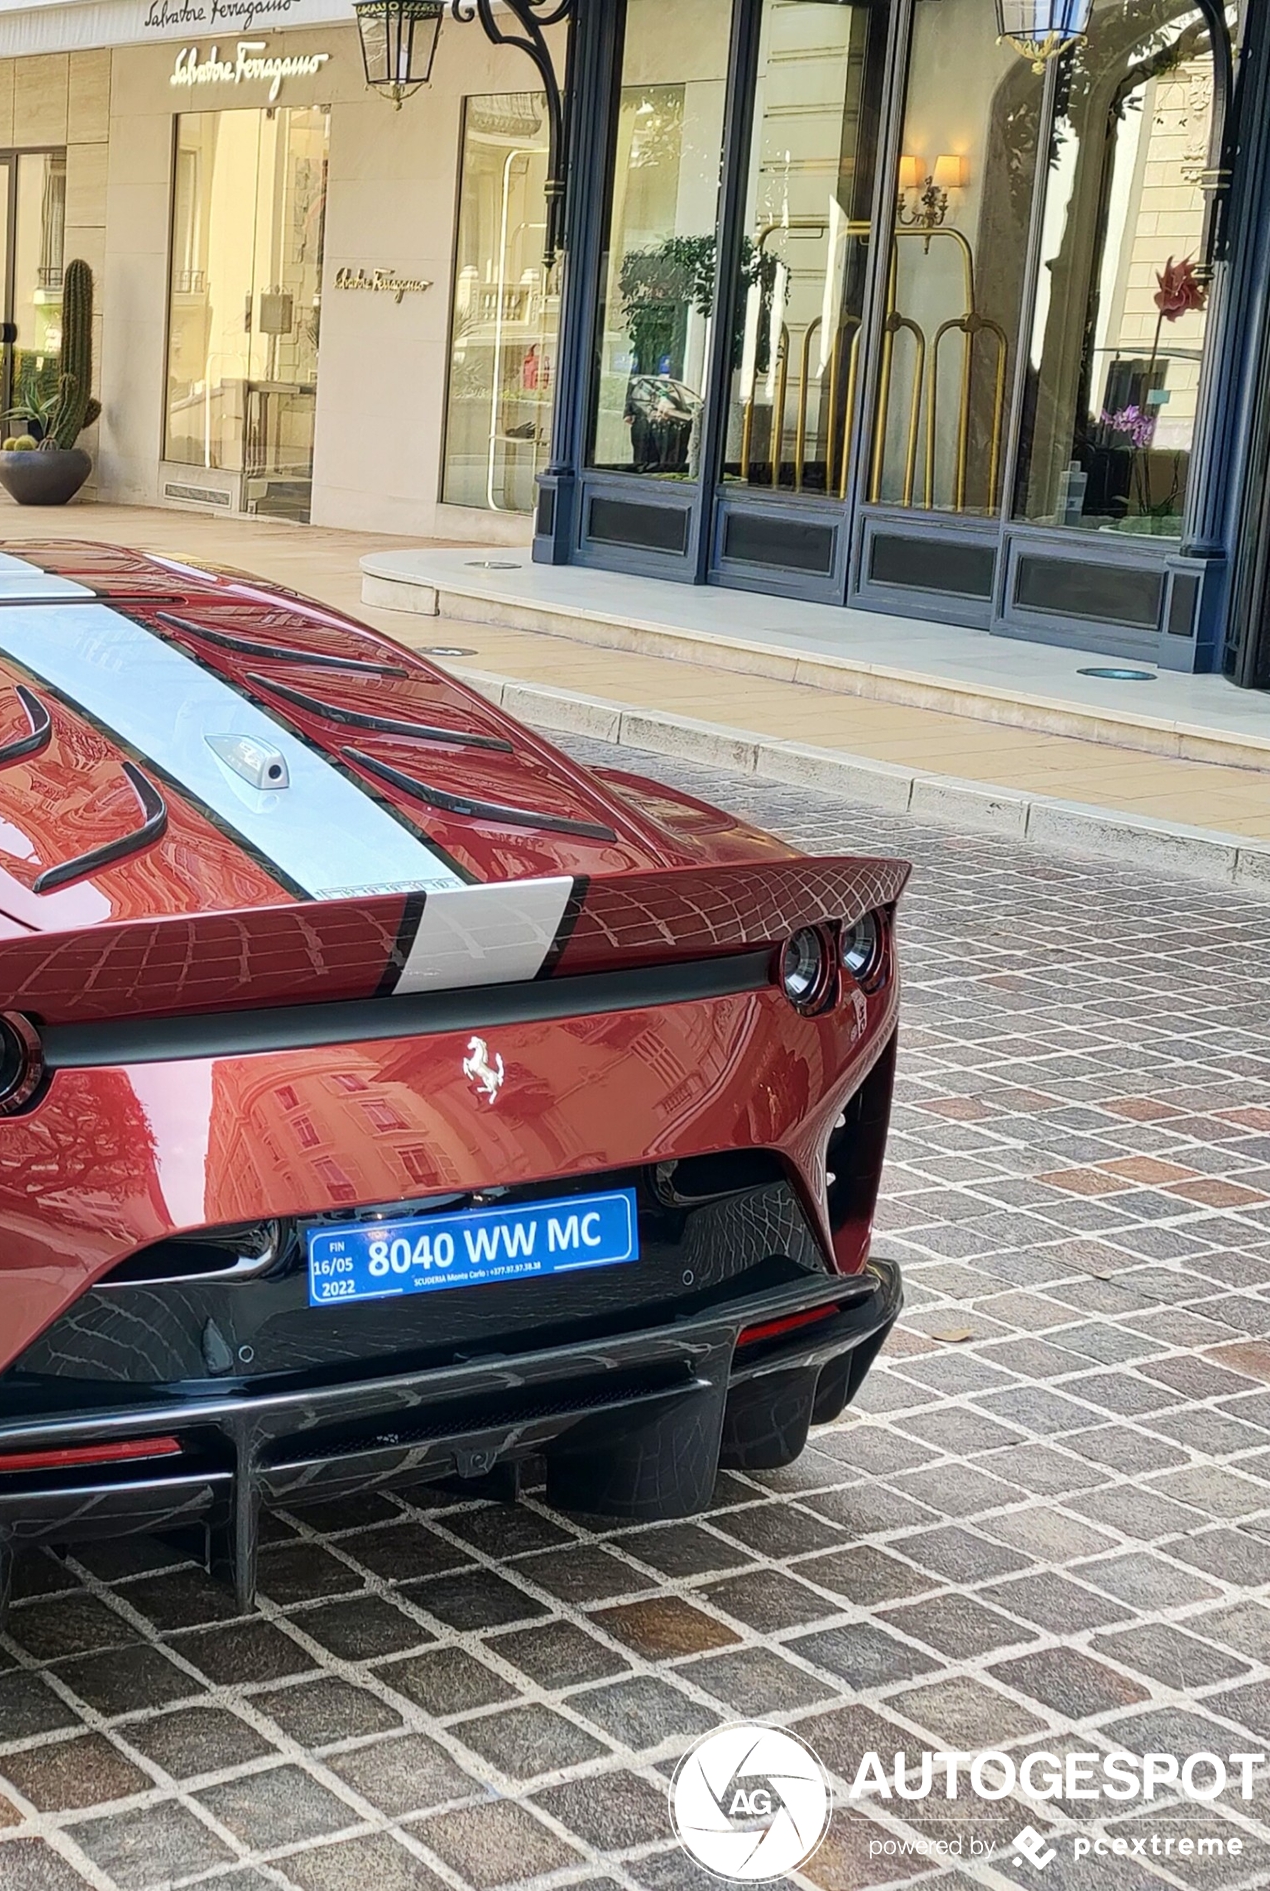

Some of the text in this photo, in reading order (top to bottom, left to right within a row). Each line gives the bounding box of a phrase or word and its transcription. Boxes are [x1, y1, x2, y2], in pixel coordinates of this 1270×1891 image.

[145, 0, 206, 28] Salvatore
[170, 41, 330, 102] Salvatore Ferragamo
[329, 1241, 345, 1253] FIN
[368, 1211, 602, 1277] 8040 WW MC
[314, 1257, 354, 1277] 16/05
[322, 1279, 356, 1297] 2022
[413, 1274, 446, 1287] SCUDERIA
[447, 1272, 468, 1283] Monte
[469, 1269, 486, 1280] Carlo
